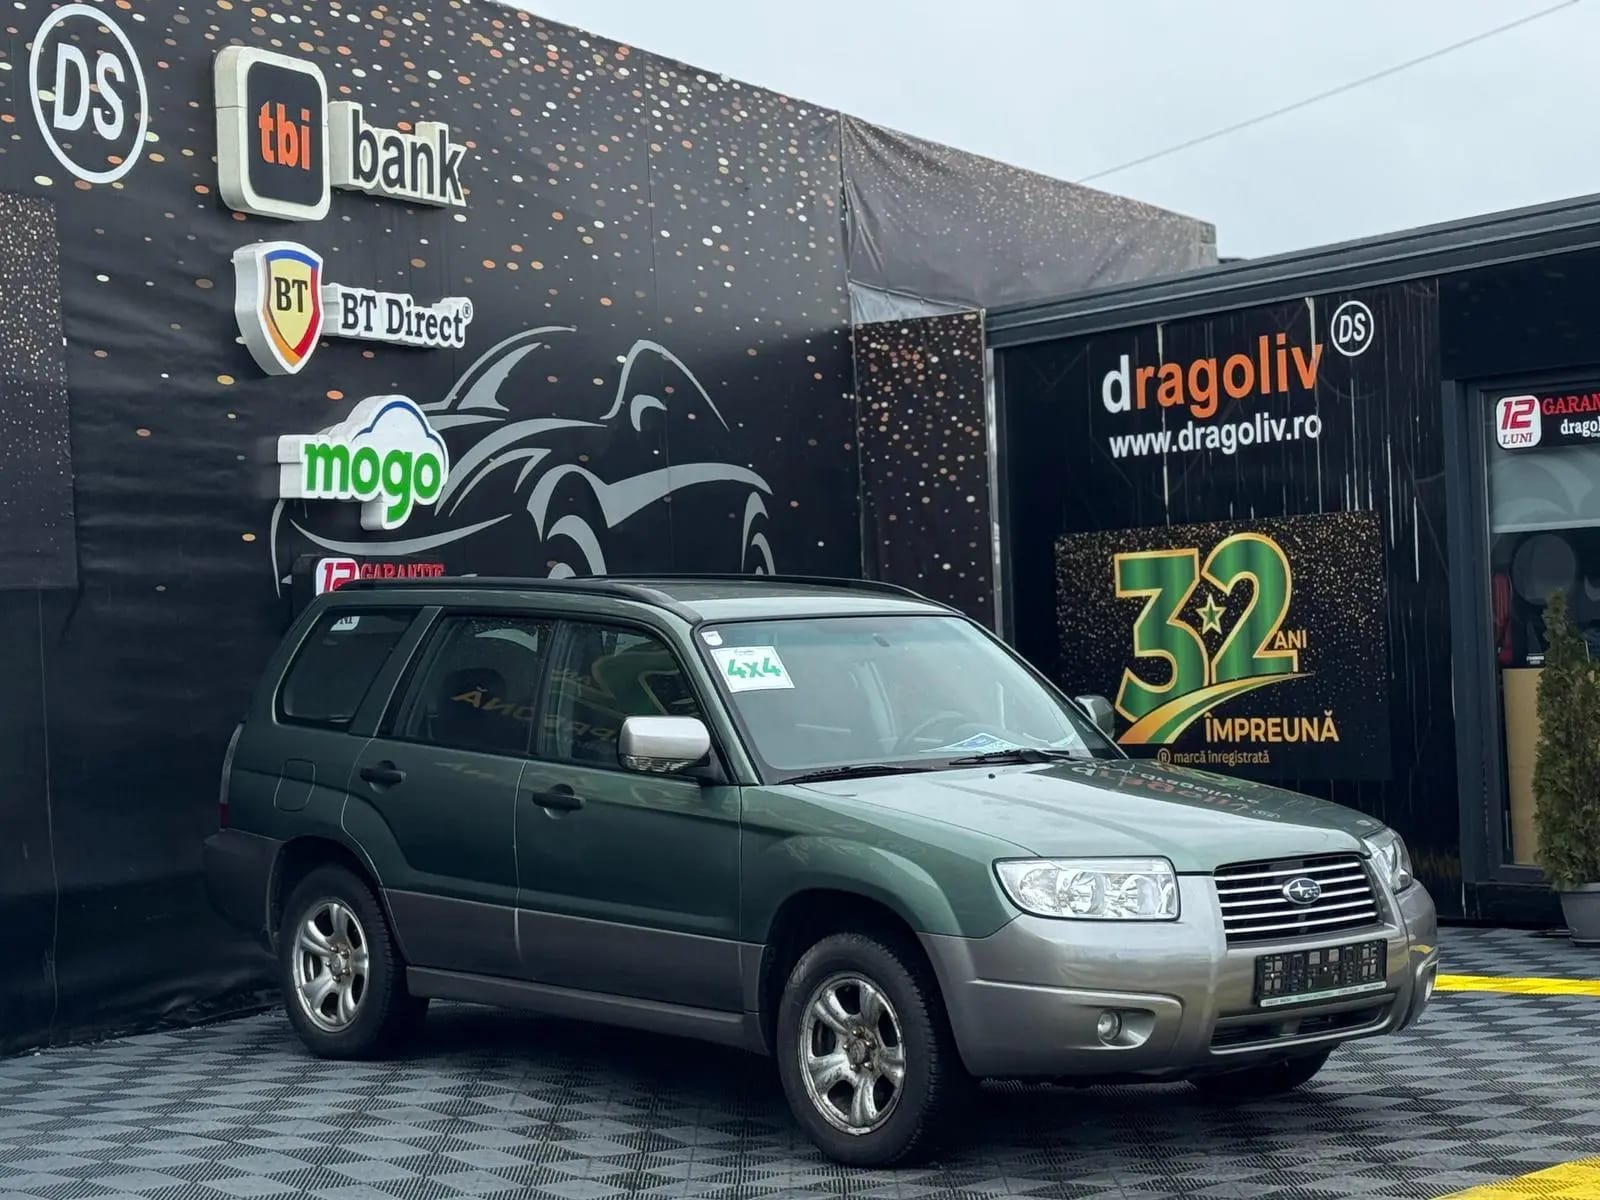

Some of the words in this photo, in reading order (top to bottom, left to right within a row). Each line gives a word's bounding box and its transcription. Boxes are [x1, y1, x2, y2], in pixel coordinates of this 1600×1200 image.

[54, 43, 126, 141] DS
[258, 101, 311, 171] tbi
[351, 109, 465, 201] bank
[274, 276, 308, 313] BT
[341, 292, 377, 332] BT
[1338, 312, 1366, 344] DS
[1102, 333, 1323, 418] dragoliv
[1501, 399, 1536, 430] 12
[1109, 412, 1323, 458] www.dragoliv.ro
[1502, 432, 1533, 445] LUNI
[304, 442, 442, 522] mogo
[1113, 532, 1299, 722] 32
[1274, 630, 1307, 650] ANI
[1204, 709, 1340, 742] ÎMPREUNĂ
